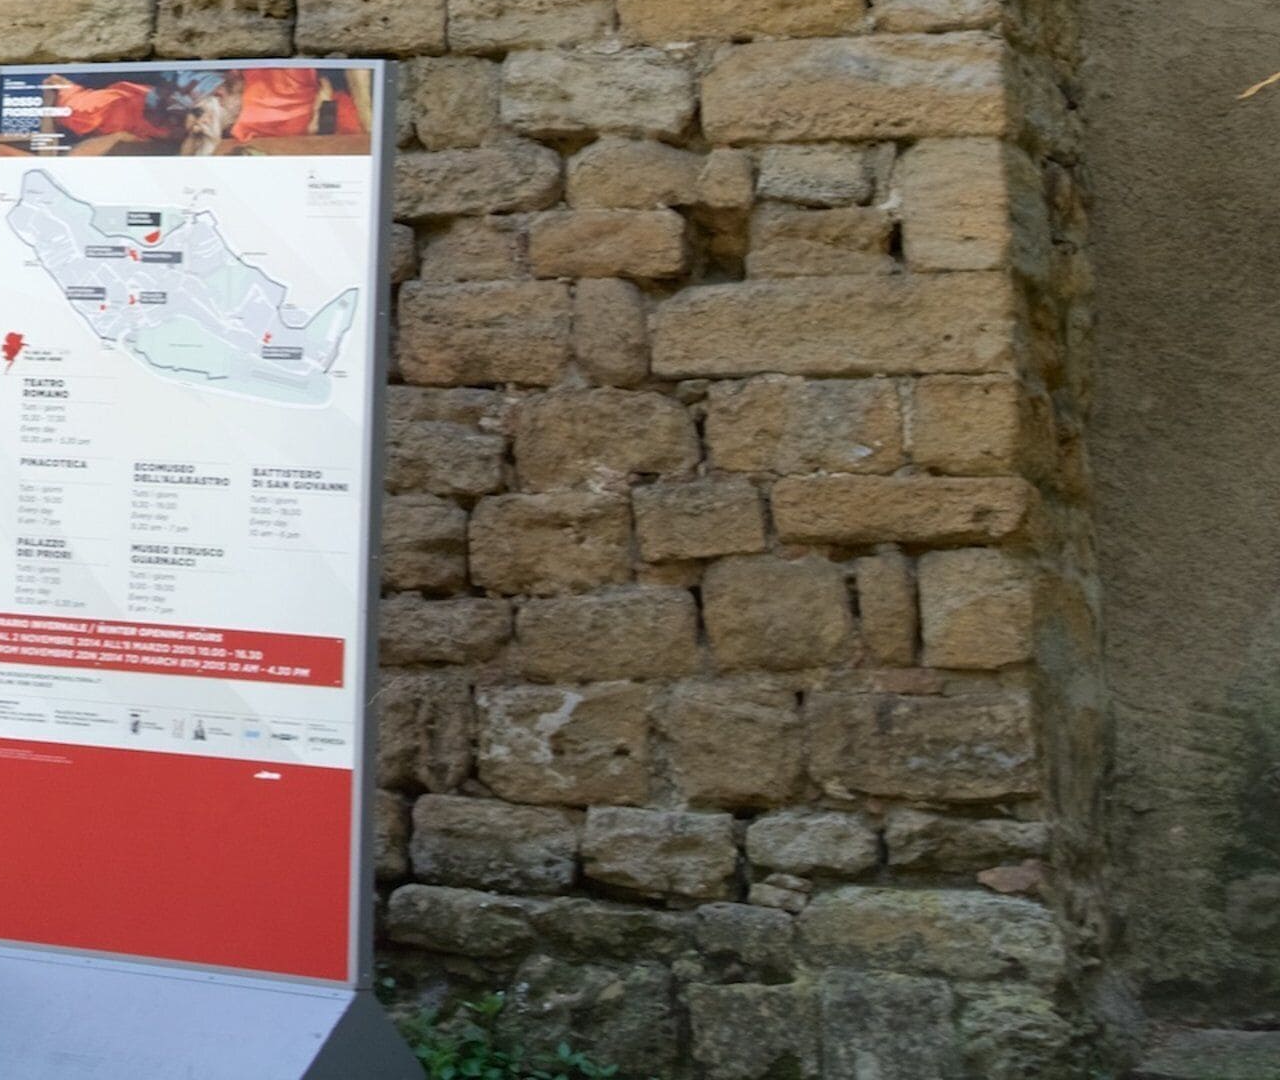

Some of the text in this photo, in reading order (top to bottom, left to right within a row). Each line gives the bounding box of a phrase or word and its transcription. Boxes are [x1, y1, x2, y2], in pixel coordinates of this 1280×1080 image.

[23, 378, 64, 388] TEATRO
[22, 389, 69, 398] ROMANO
[20, 457, 88, 469] PINACOTECA
[133, 462, 196, 474] ECOMUSEO
[133, 473, 231, 486] DELL'ALABASTRO
[252, 467, 323, 480] BATTISTERO
[252, 479, 349, 492] DI SAN GIOVANNI
[17, 537, 66, 548] PALAZZO
[17, 548, 72, 559] DEI PRIORI
[131, 544, 224, 557] MUSEO ETRUSCO
[131, 555, 196, 567] GUARNACCI
[31, 619, 87, 633] INVERNALE
[96, 624, 137, 636] WINTER
[138, 627, 185, 640] OPENING
[186, 630, 223, 643] HOURS
[20, 633, 75, 645] NOVEMBRE
[132, 641, 171, 653] MARZO
[124, 654, 140, 664] TO
[141, 655, 179, 667] MARCH
[241, 663, 260, 673] AM
[292, 667, 312, 678] PM
